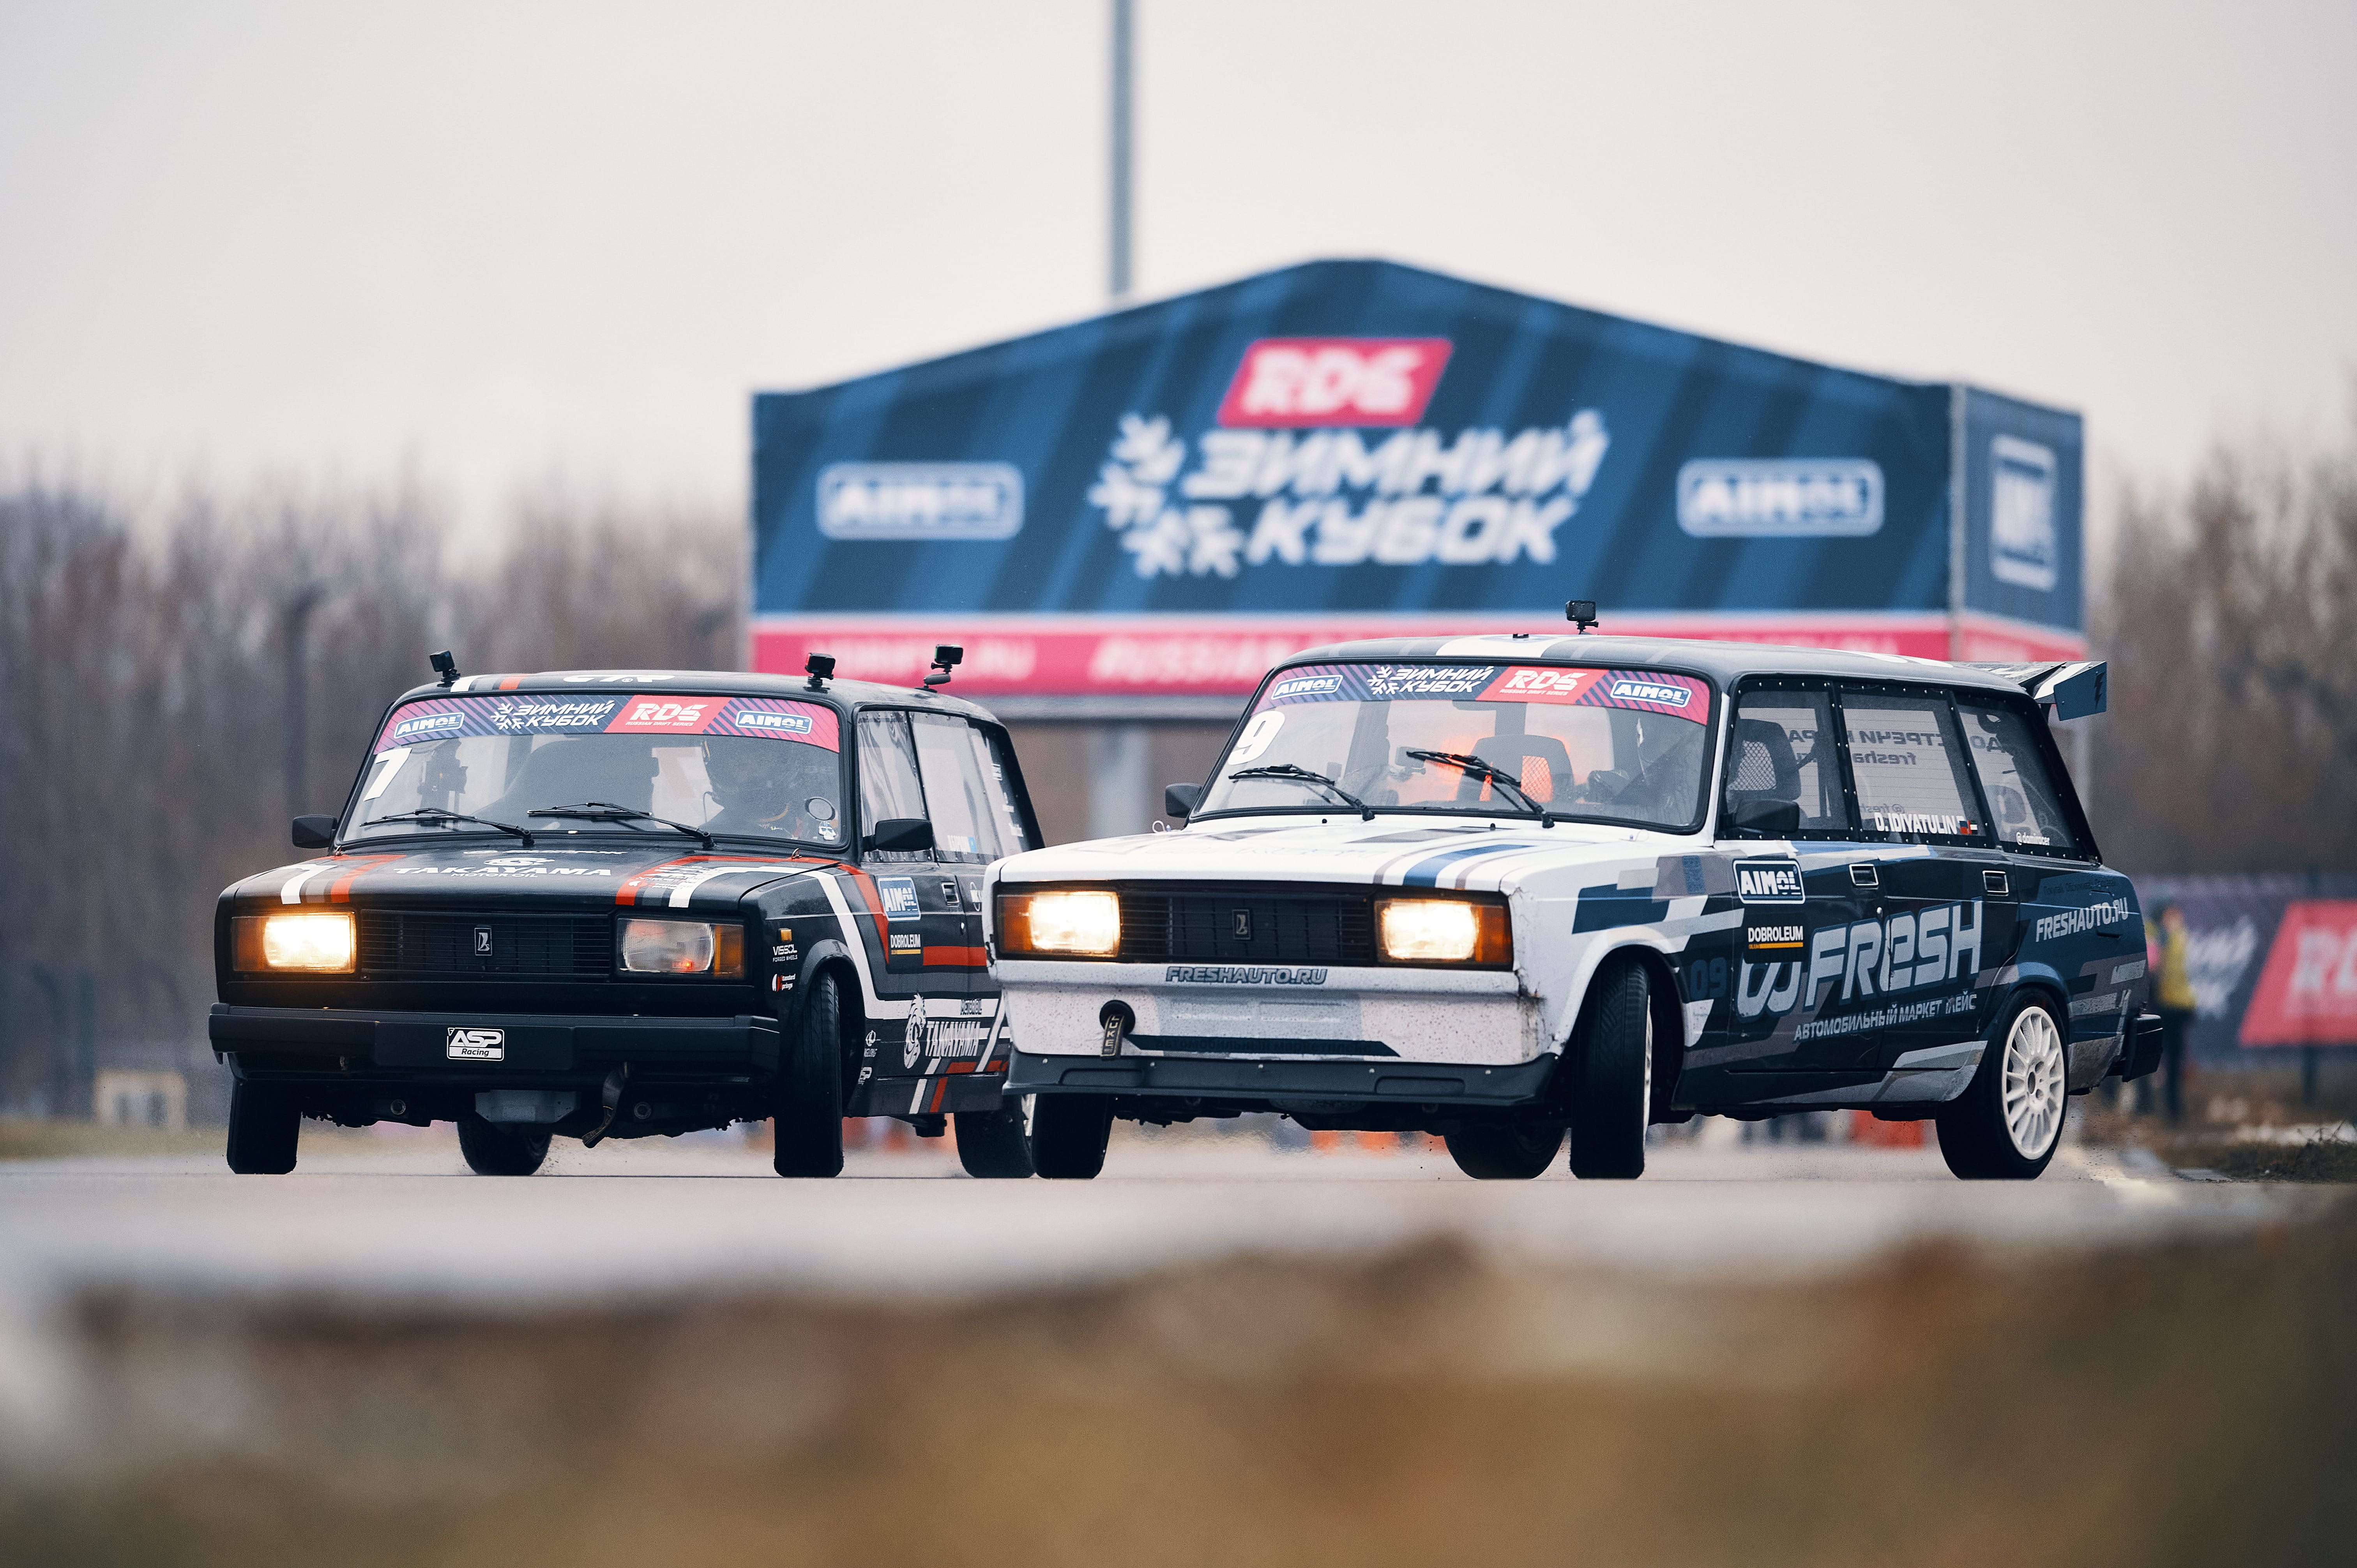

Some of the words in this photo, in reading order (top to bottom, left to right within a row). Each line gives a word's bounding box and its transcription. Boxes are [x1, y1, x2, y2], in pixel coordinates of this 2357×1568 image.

[1183, 410, 1608, 499] ЗИМНИЙ
[1245, 496, 1580, 566] КУБОК
[1395, 667, 1494, 680] ЗИМНИЙ
[1505, 670, 1588, 690] RDS
[1276, 680, 1336, 696] AIMOL
[1399, 680, 1482, 692] КУБОК
[1614, 683, 1685, 702] AIMOL
[513, 700, 615, 716] ЗИМНИЙ
[630, 703, 708, 721] RDS
[396, 716, 460, 735] AIMOL
[525, 715, 605, 726] КУБОК
[738, 714, 809, 731] AIMOL
[1228, 710, 1285, 765] 9
[1887, 812, 1958, 835] IDIYATULIN
[393, 867, 611, 876] TAKAYAMA
[1740, 871, 1801, 895] AIMOL
[883, 887, 918, 912] AIMOL
[2035, 897, 2129, 942] FRESHAUTO.RU
[890, 934, 921, 948] DOBROLEUM
[1748, 926, 1803, 942] DOBROLEUM
[1166, 966, 1328, 985] FRESHAUTO.RU
[1691, 957, 1727, 1001] 09
[1105, 1015, 1120, 1047] LUKE
[1793, 1001, 1899, 1042] АВТОМОБИЛЬНЫЙ
[449, 1030, 502, 1047] ASP
[925, 1021, 981, 1057] TAKAYAMA
[461, 1048, 489, 1057] Racing
